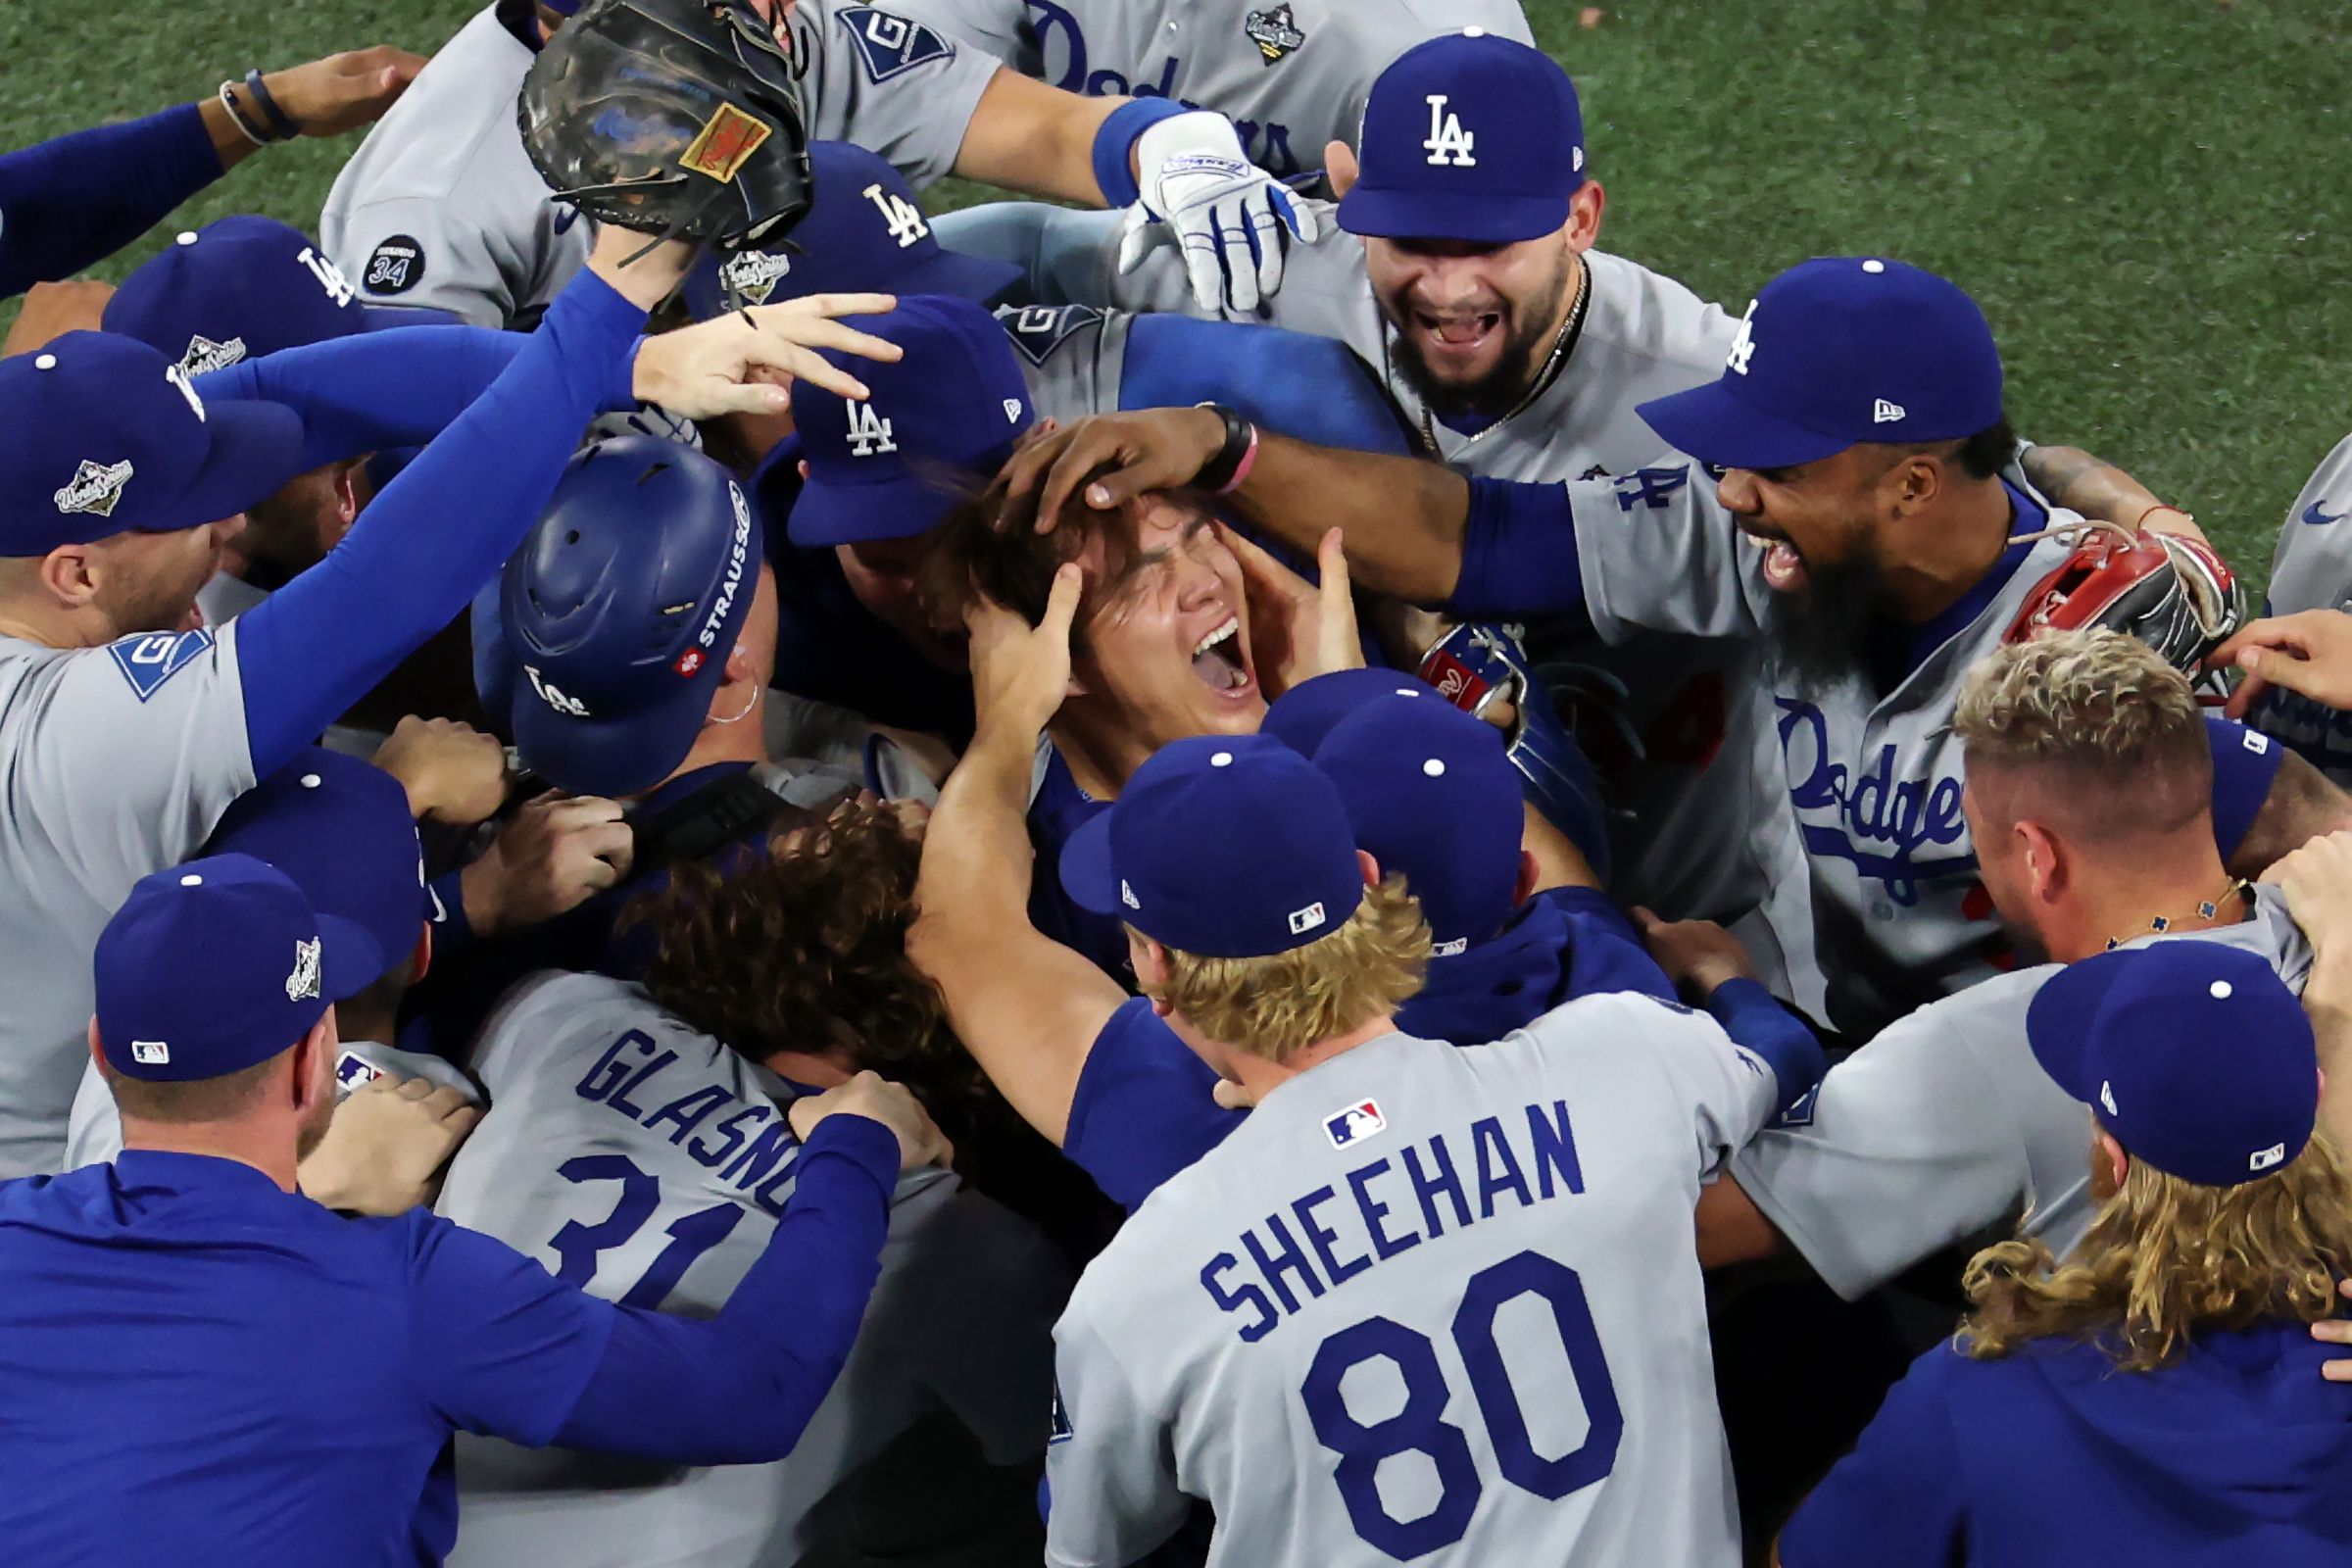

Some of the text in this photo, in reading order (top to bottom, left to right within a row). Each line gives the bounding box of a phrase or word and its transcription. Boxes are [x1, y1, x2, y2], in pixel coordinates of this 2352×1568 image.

[1423, 95, 1476, 167] LA
[862, 184, 929, 248] LA
[297, 247, 355, 308] LA
[368, 257, 410, 287] 34
[1727, 299, 1760, 375] LA
[846, 398, 898, 457] LA
[700, 527, 750, 648] STRAUSS
[523, 664, 590, 716] LA
[1775, 695, 1964, 906] Dodge
[575, 1028, 800, 1221] GLASN
[1200, 1100, 1586, 1343] SHEEHAN
[1300, 1250, 1624, 1562] 80
